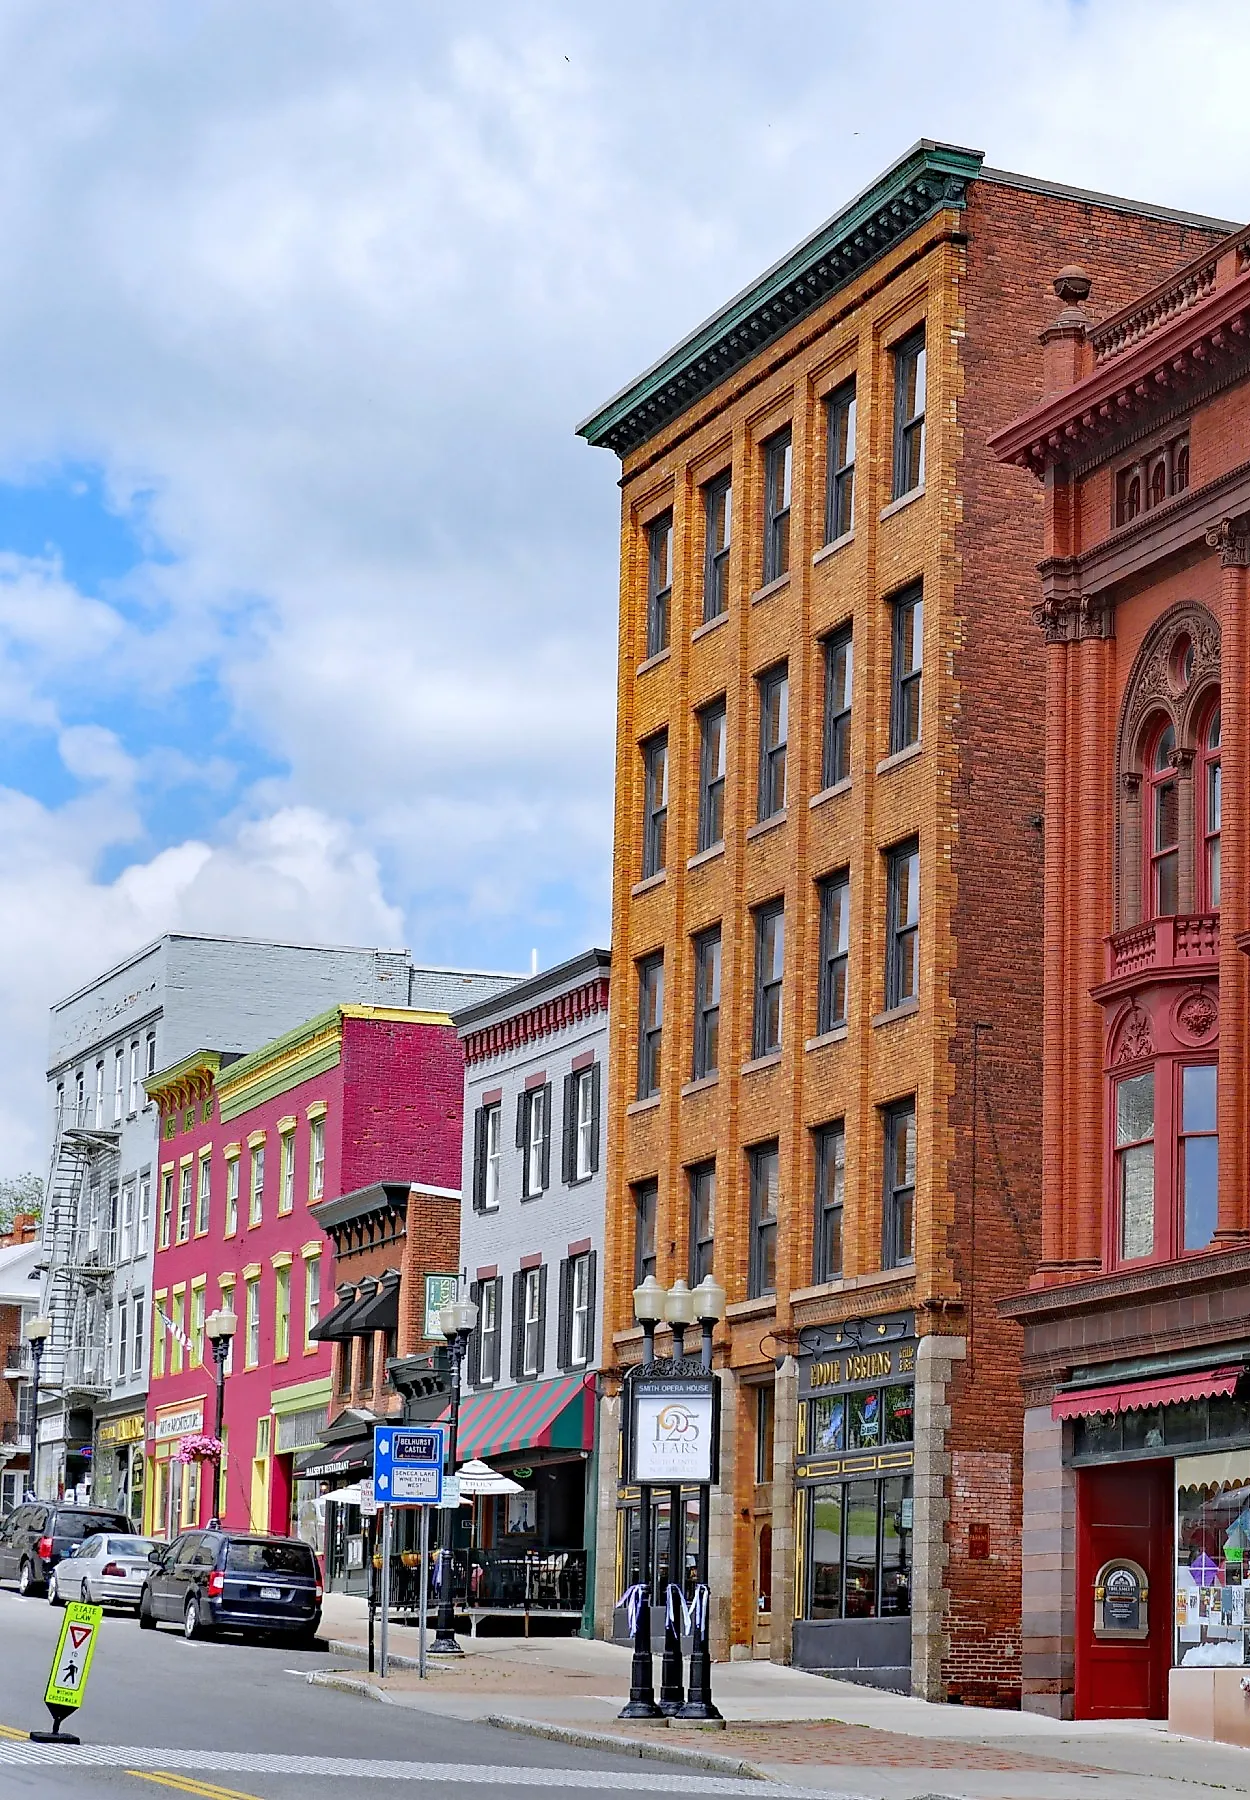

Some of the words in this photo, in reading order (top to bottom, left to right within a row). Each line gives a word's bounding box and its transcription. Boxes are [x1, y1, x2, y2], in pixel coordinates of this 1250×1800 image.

[810, 1360, 841, 1387] EDDIE
[652, 1406, 700, 1442] 125
[400, 1438, 431, 1446] BELHURST
[404, 1446, 427, 1454] CASTLE
[652, 1442, 698, 1454] YEARS
[74, 1605, 97, 1615] STATE
